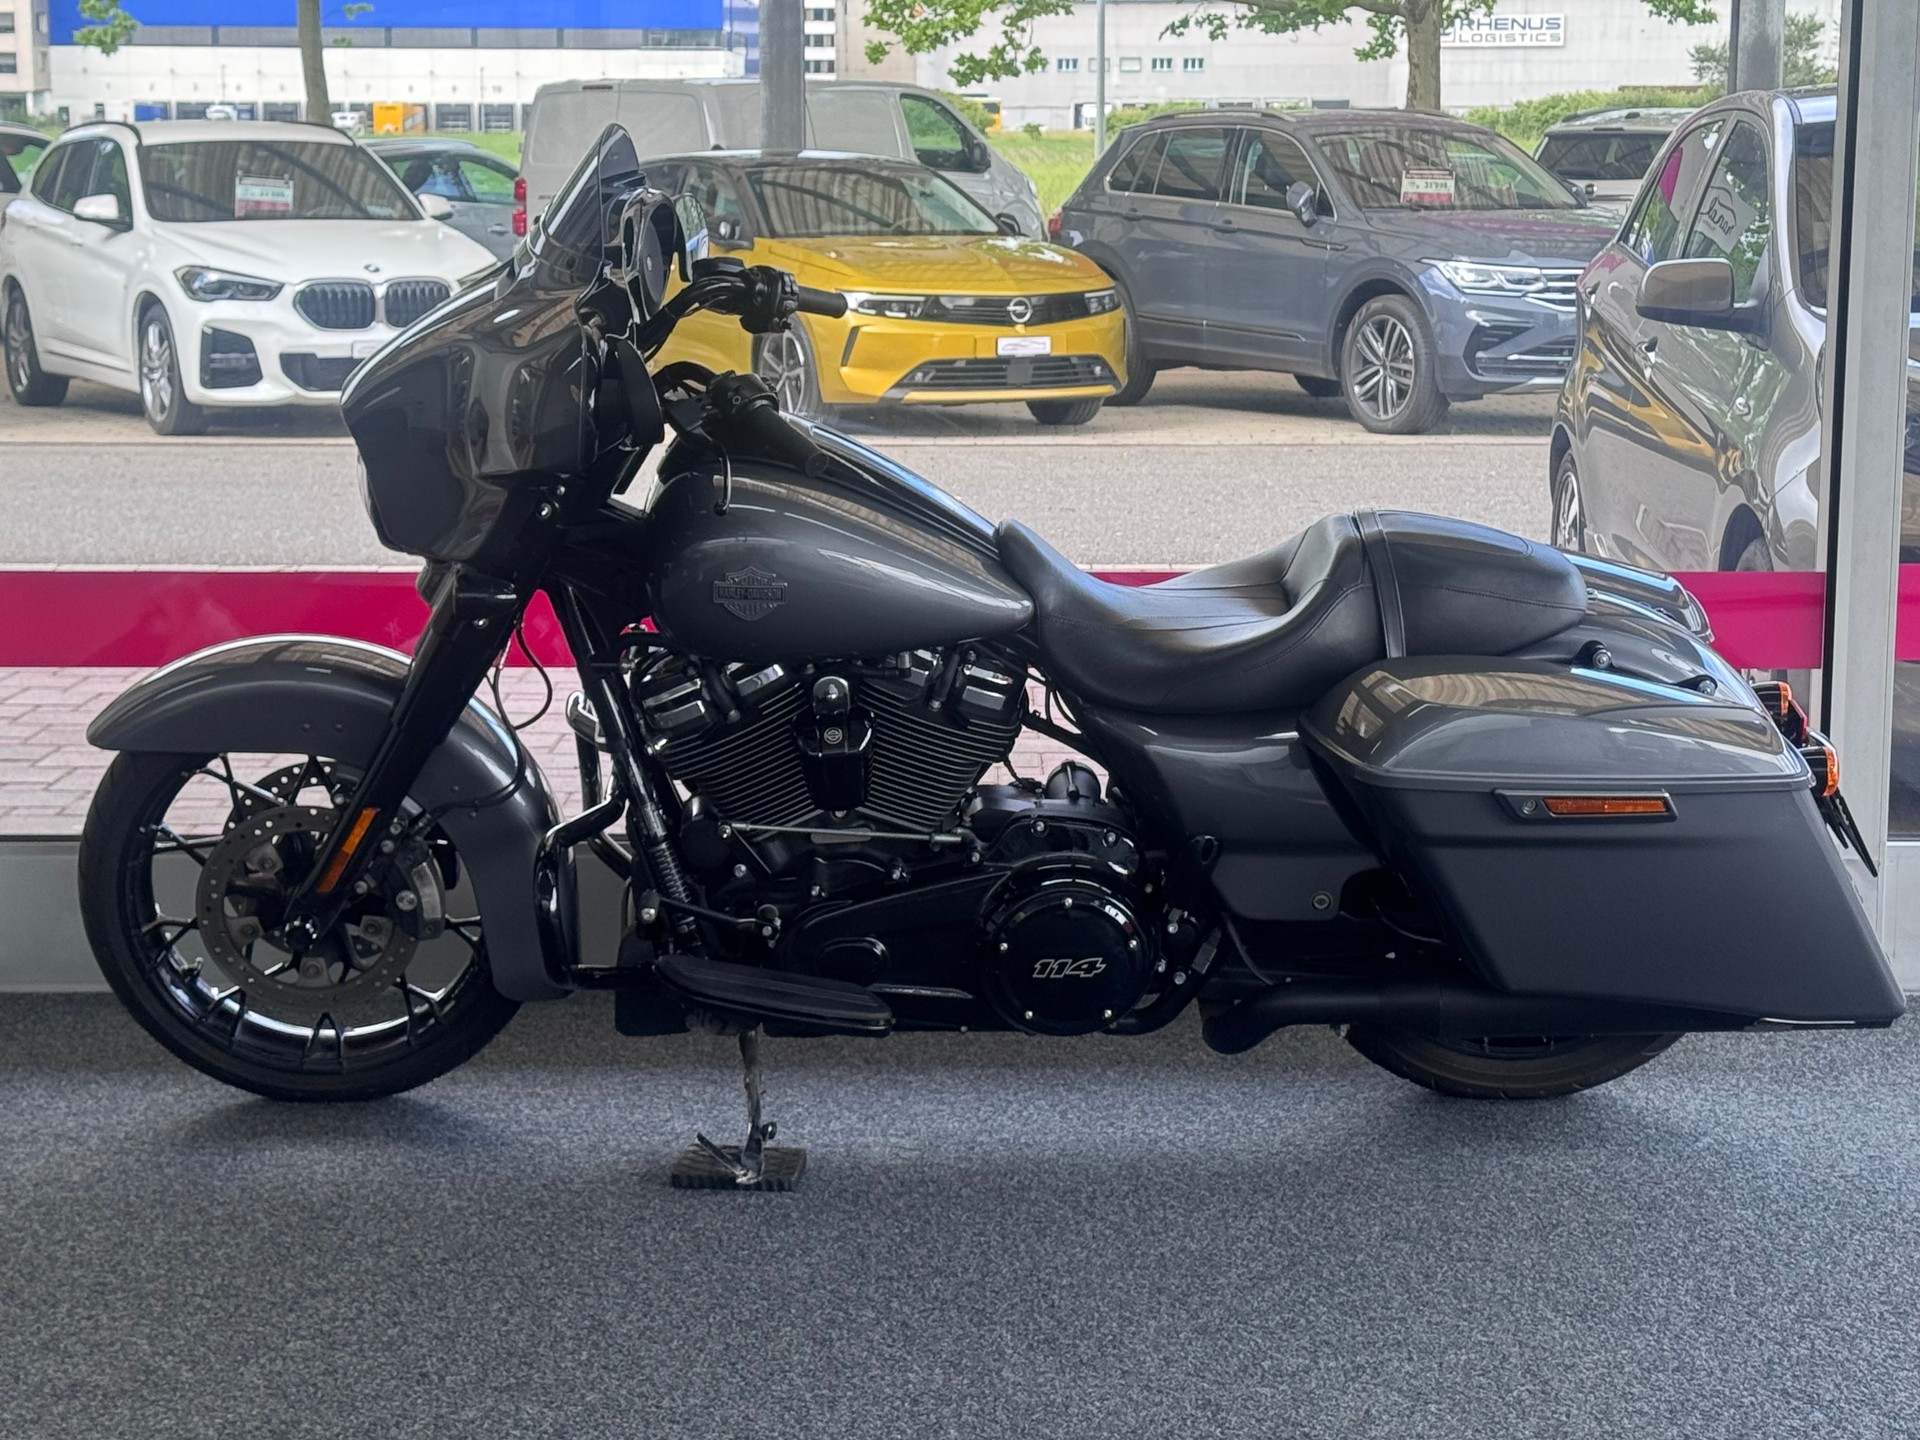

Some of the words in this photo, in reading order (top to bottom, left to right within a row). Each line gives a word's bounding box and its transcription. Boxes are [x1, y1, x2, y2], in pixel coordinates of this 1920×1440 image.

[1460, 17, 1561, 31] RHENUS
[1459, 33, 1561, 43] LOGISTICS
[1033, 957, 1107, 978] 114
